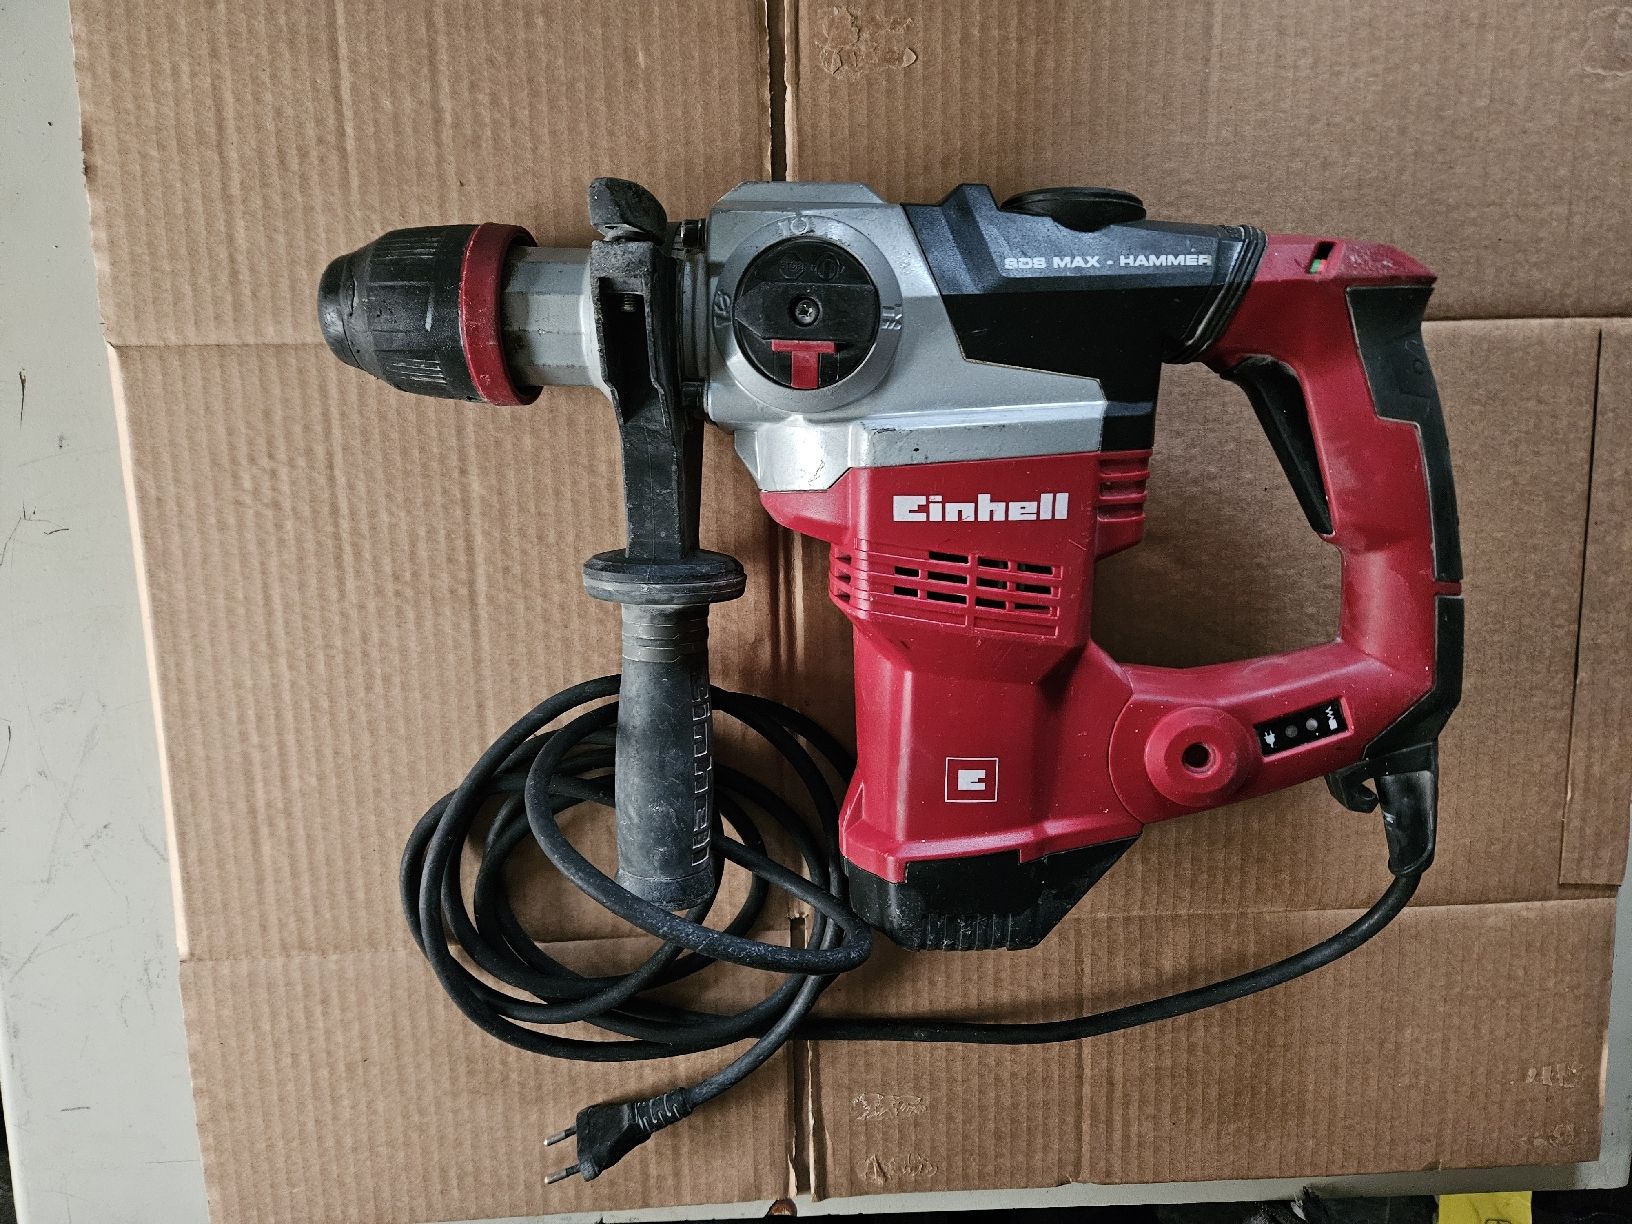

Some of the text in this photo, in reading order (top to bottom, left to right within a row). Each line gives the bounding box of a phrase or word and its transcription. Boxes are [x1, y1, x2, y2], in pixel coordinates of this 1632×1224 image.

[1004, 257, 1047, 269] SDS
[1052, 255, 1100, 268] MAX
[1119, 254, 1213, 267] HAMMER
[893, 492, 1069, 521] Einhell
